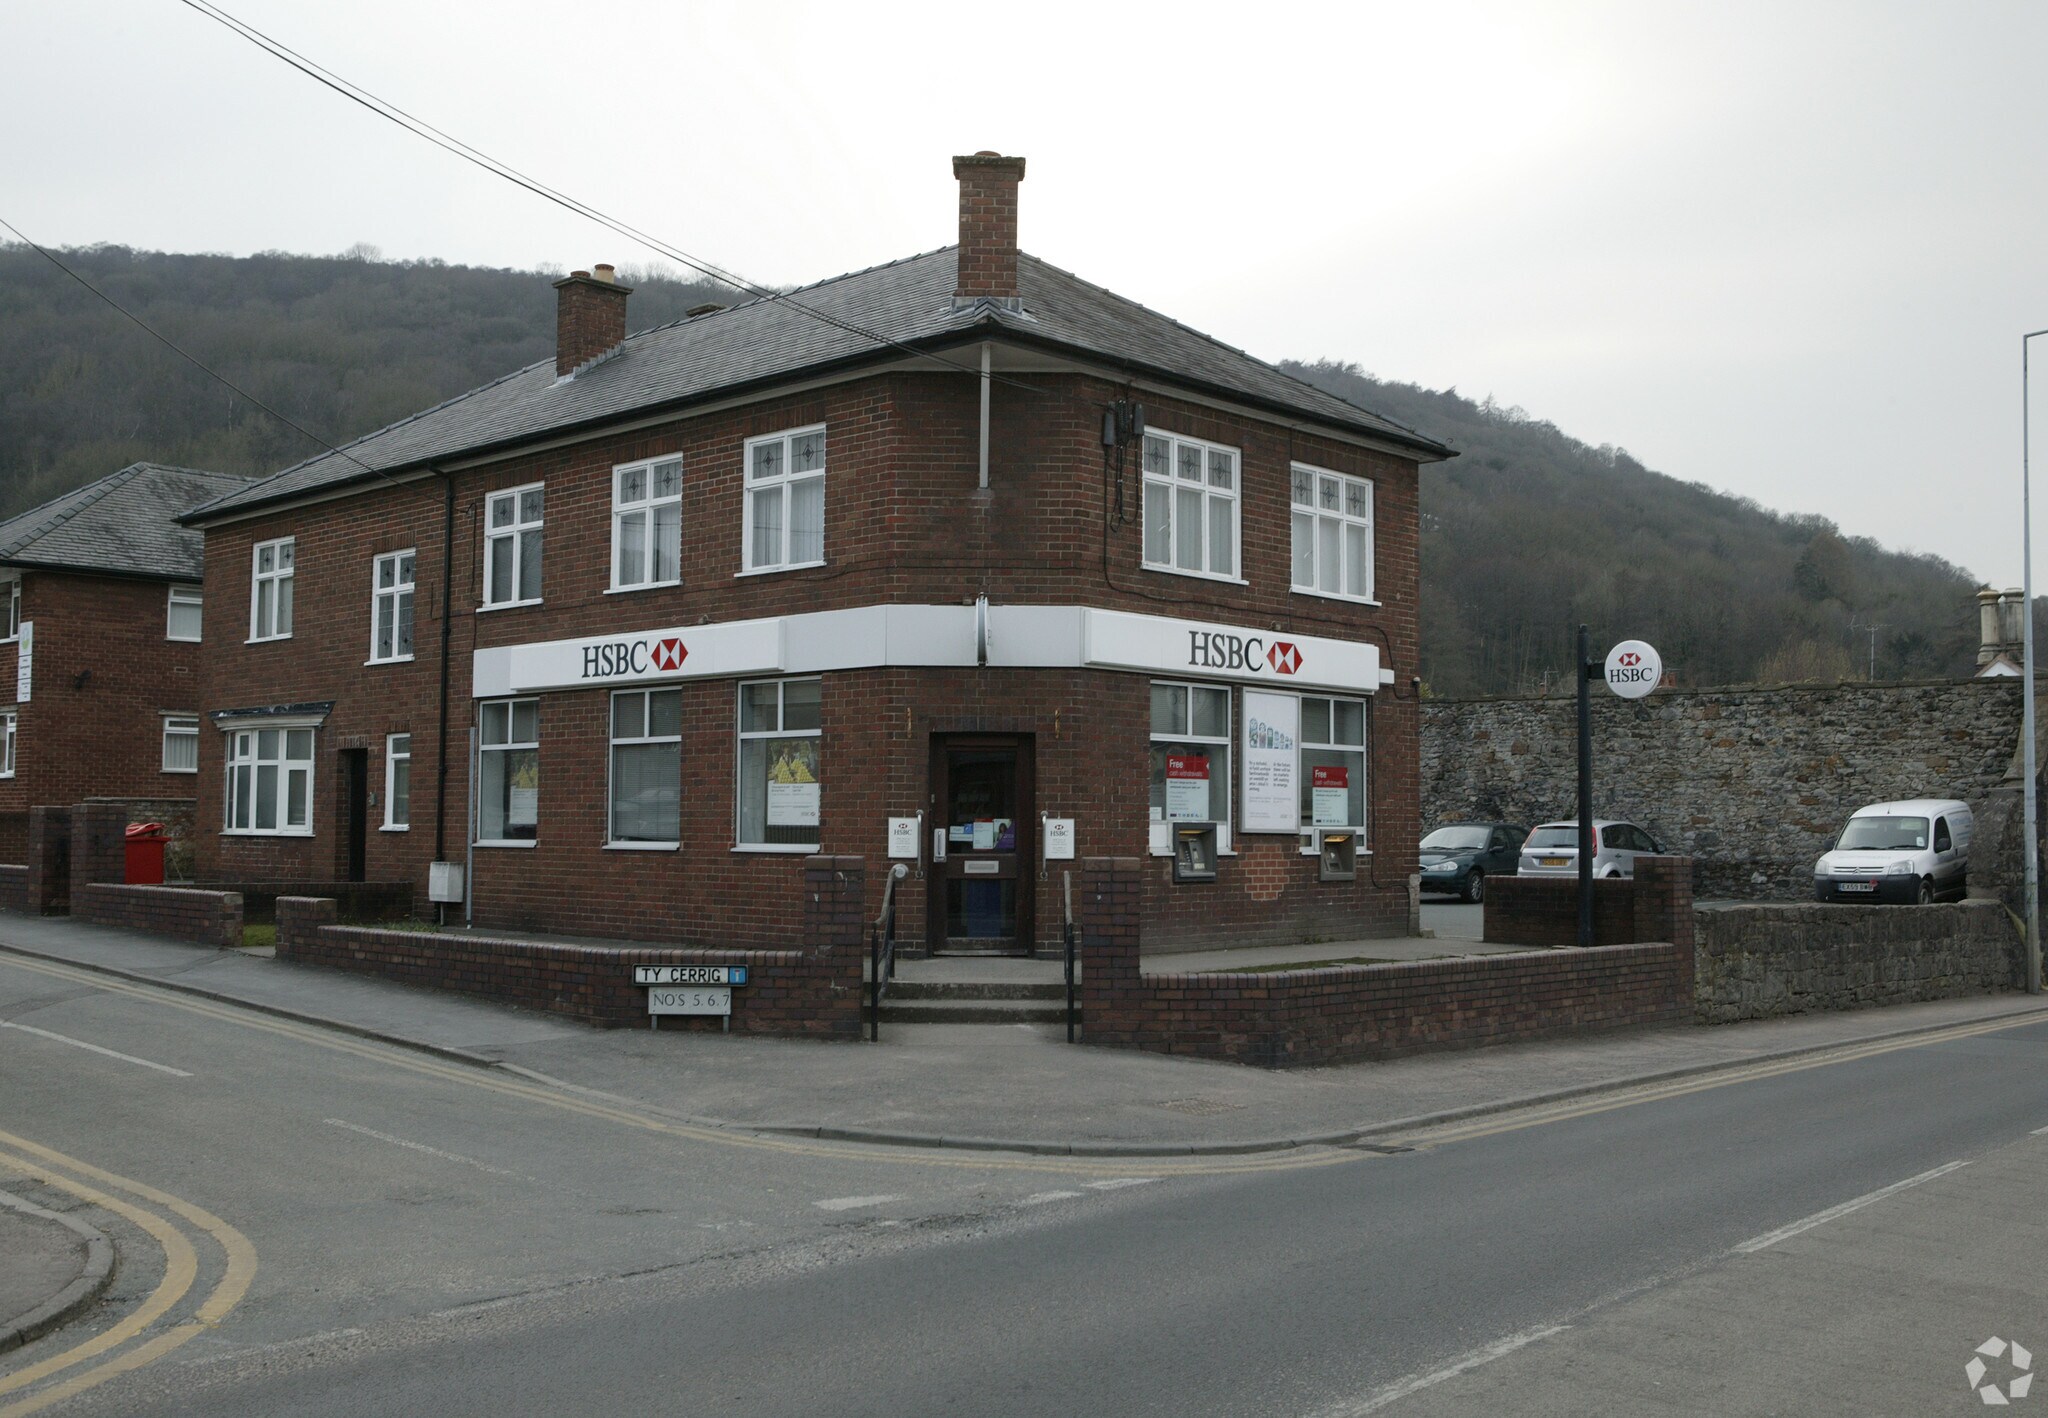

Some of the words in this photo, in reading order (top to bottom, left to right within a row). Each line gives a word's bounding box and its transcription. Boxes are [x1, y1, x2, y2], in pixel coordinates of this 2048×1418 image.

[1188, 630, 1263, 672] HSBC
[582, 640, 648, 678] HSBC
[1609, 667, 1653, 683] HSBC
[1169, 758, 1184, 769] Free
[1314, 769, 1327, 779] Free
[641, 968, 662, 982] TY
[670, 968, 721, 982] CERRIG
[653, 993, 685, 1007] NO'S
